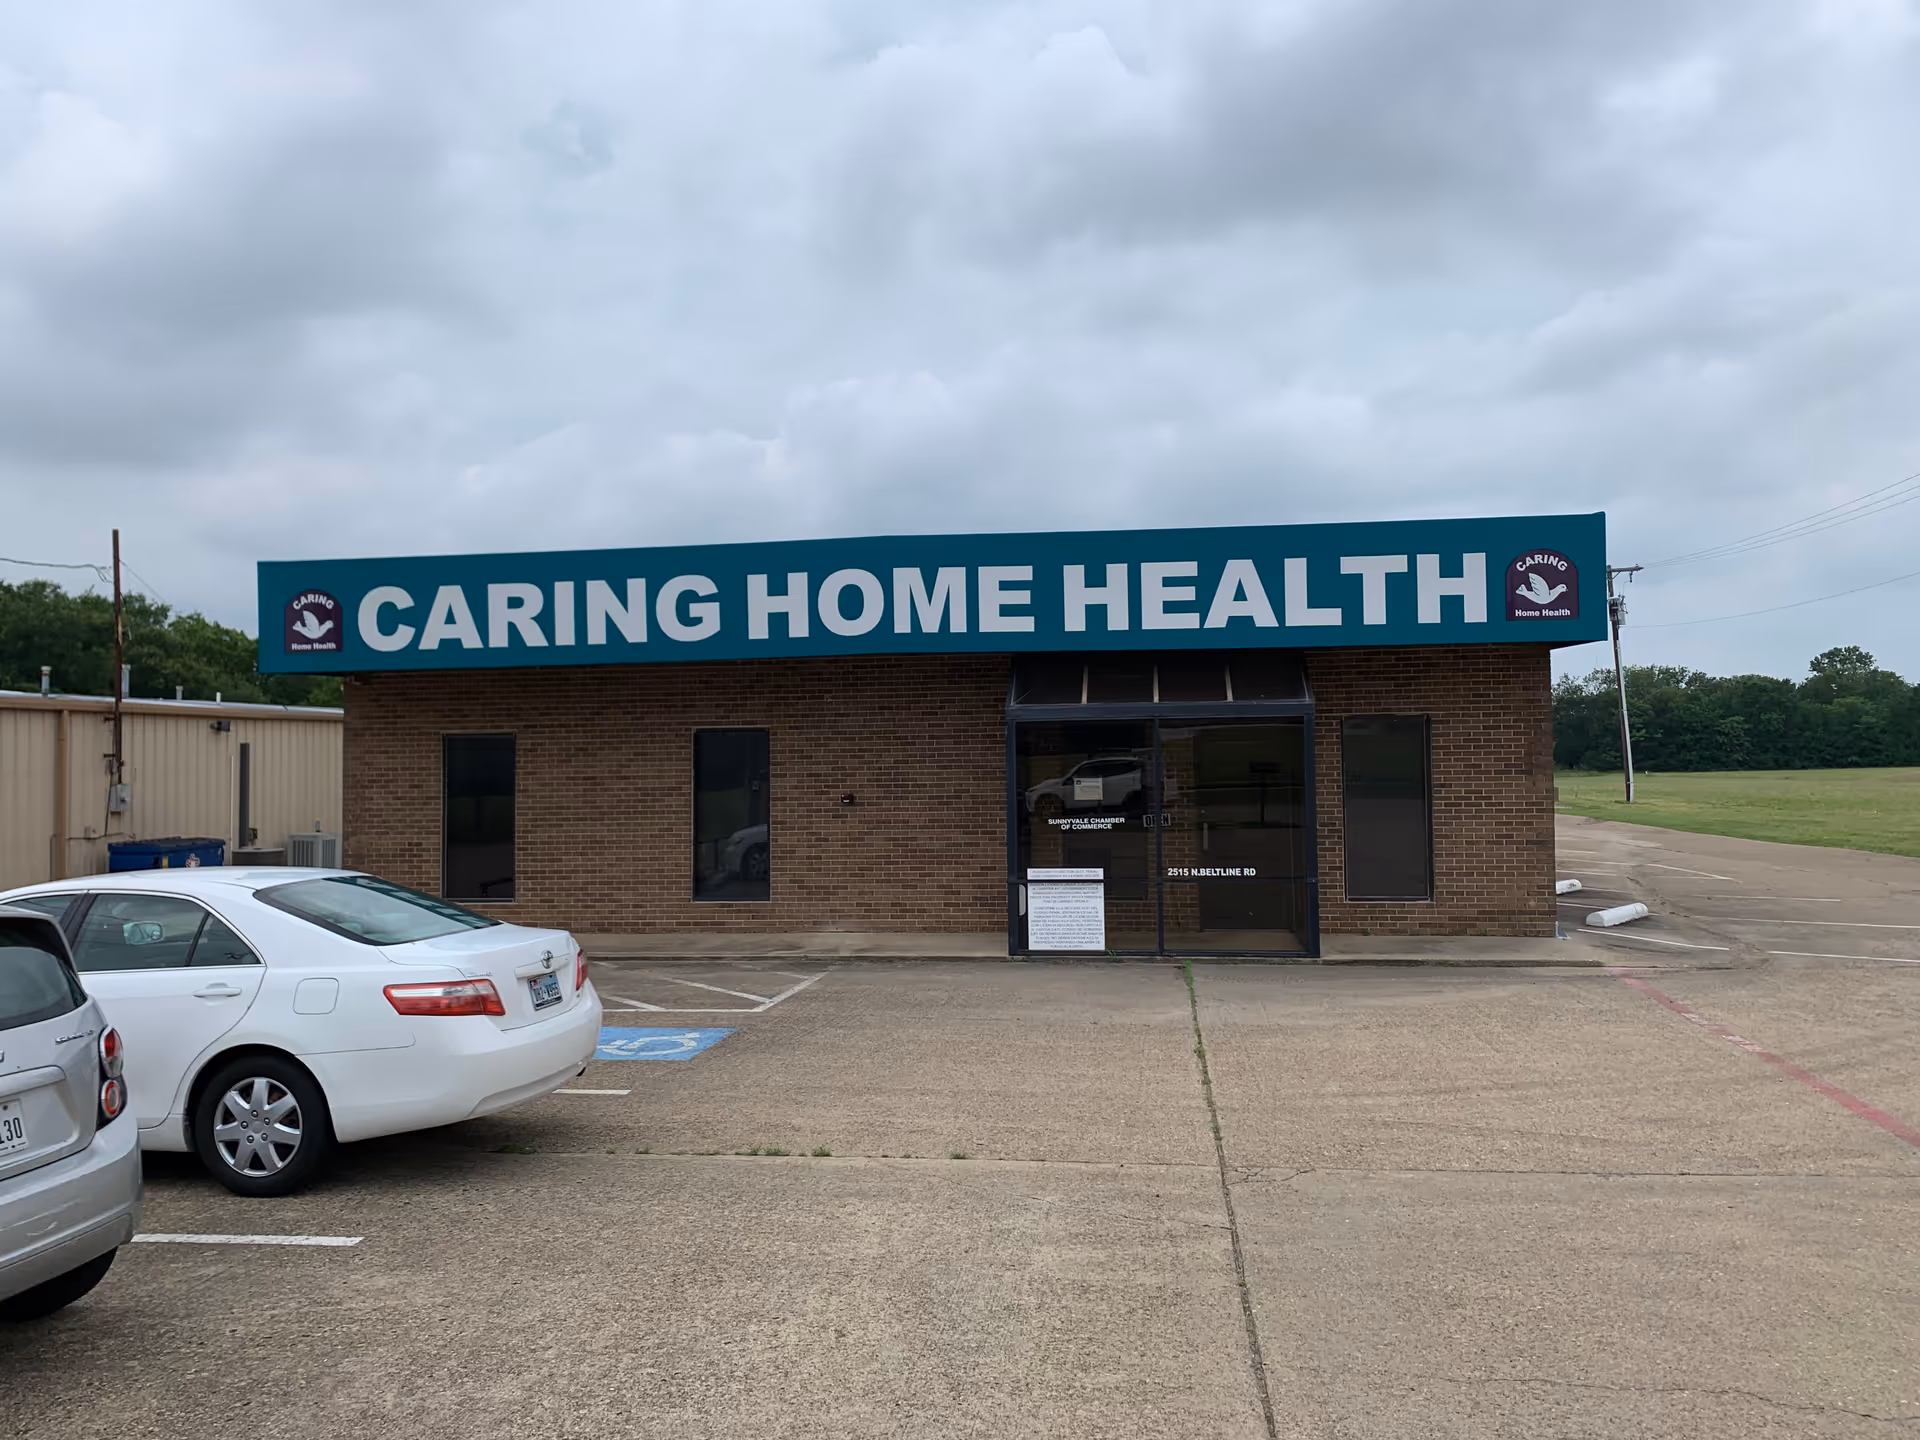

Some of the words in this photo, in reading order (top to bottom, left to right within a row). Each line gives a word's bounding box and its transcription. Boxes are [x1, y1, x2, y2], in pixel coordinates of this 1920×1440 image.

[1516, 554, 1568, 571] CARING
[292, 593, 334, 610] CARING
[358, 574, 721, 652] CARING
[747, 565, 1035, 640] HOME
[1063, 552, 1488, 632] HEALTH
[1515, 609, 1540, 617] Home
[1542, 608, 1571, 616] Health
[313, 642, 336, 650] Health
[1047, 817, 1089, 825] SUNNYVALE
[1090, 817, 1126, 825] CHAMBER
[1167, 868, 1189, 876] 2515
[1243, 868, 1256, 876] RD
[0, 1117, 23, 1144] 30
